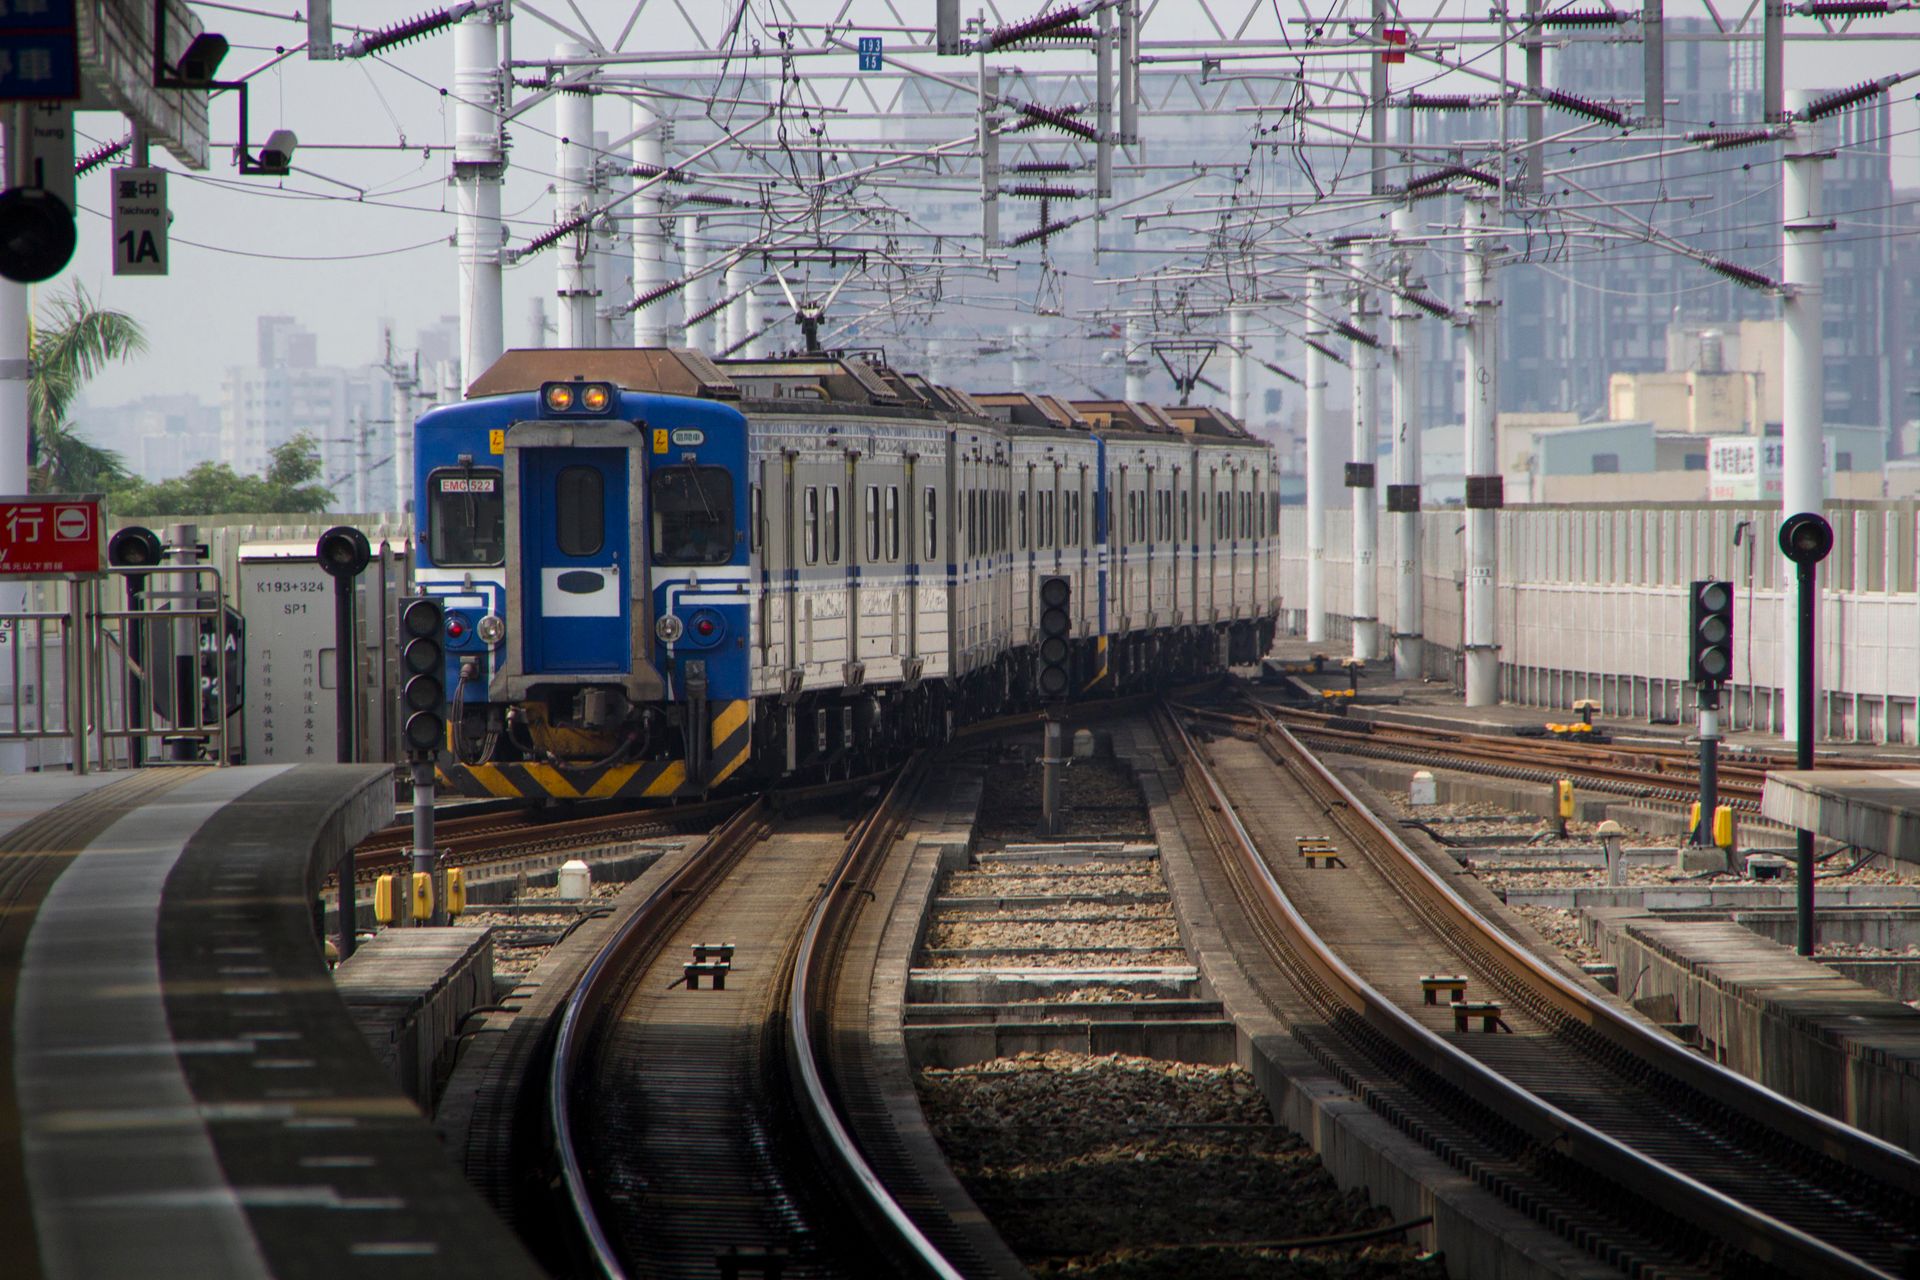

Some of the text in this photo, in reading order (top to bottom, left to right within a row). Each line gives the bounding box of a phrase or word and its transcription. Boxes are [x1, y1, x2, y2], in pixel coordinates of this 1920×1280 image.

[862, 39, 881, 51] 193
[865, 56, 877, 69] 15
[119, 180, 157, 198] 臺中
[118, 205, 160, 217] Taichung
[118, 230, 160, 263] 1A
[5, 506, 44, 543] 行
[257, 581, 325, 593] K193+324
[284, 604, 308, 614] SP1
